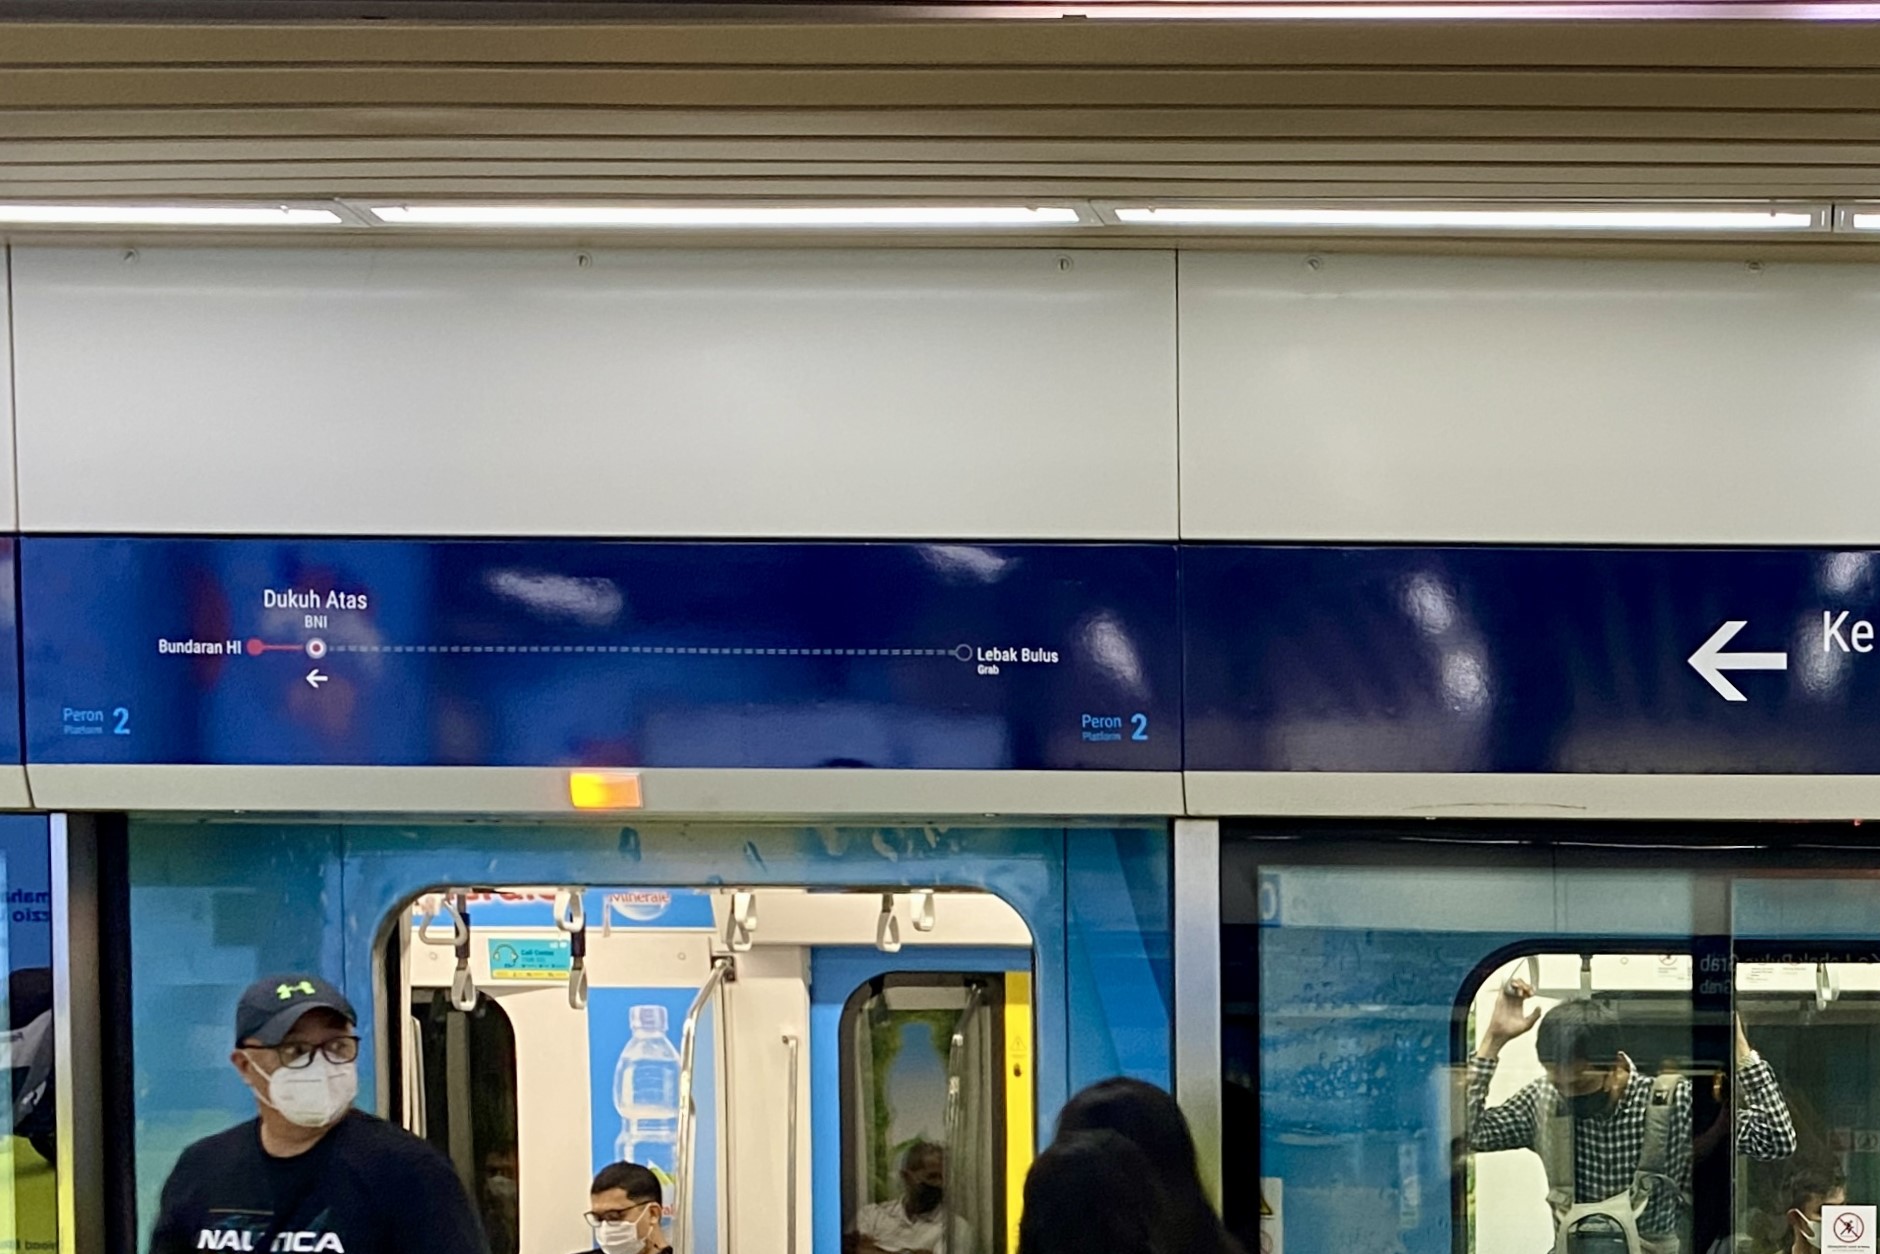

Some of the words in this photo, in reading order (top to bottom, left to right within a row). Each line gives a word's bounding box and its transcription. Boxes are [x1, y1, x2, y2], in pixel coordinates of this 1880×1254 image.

[263, 589, 321, 609] Dukuh
[326, 590, 368, 610] Atas
[304, 615, 328, 629] BNI
[1822, 611, 1874, 653] Ke
[158, 639, 223, 655] Bundaran
[226, 640, 242, 655] HI
[977, 647, 1018, 663] Lebak
[1021, 648, 1059, 664] Bulus
[977, 665, 1000, 675] Grab
[63, 708, 103, 722] Peron
[113, 707, 131, 735] 2
[1082, 714, 1122, 729] Peron
[1130, 713, 1148, 741] 2
